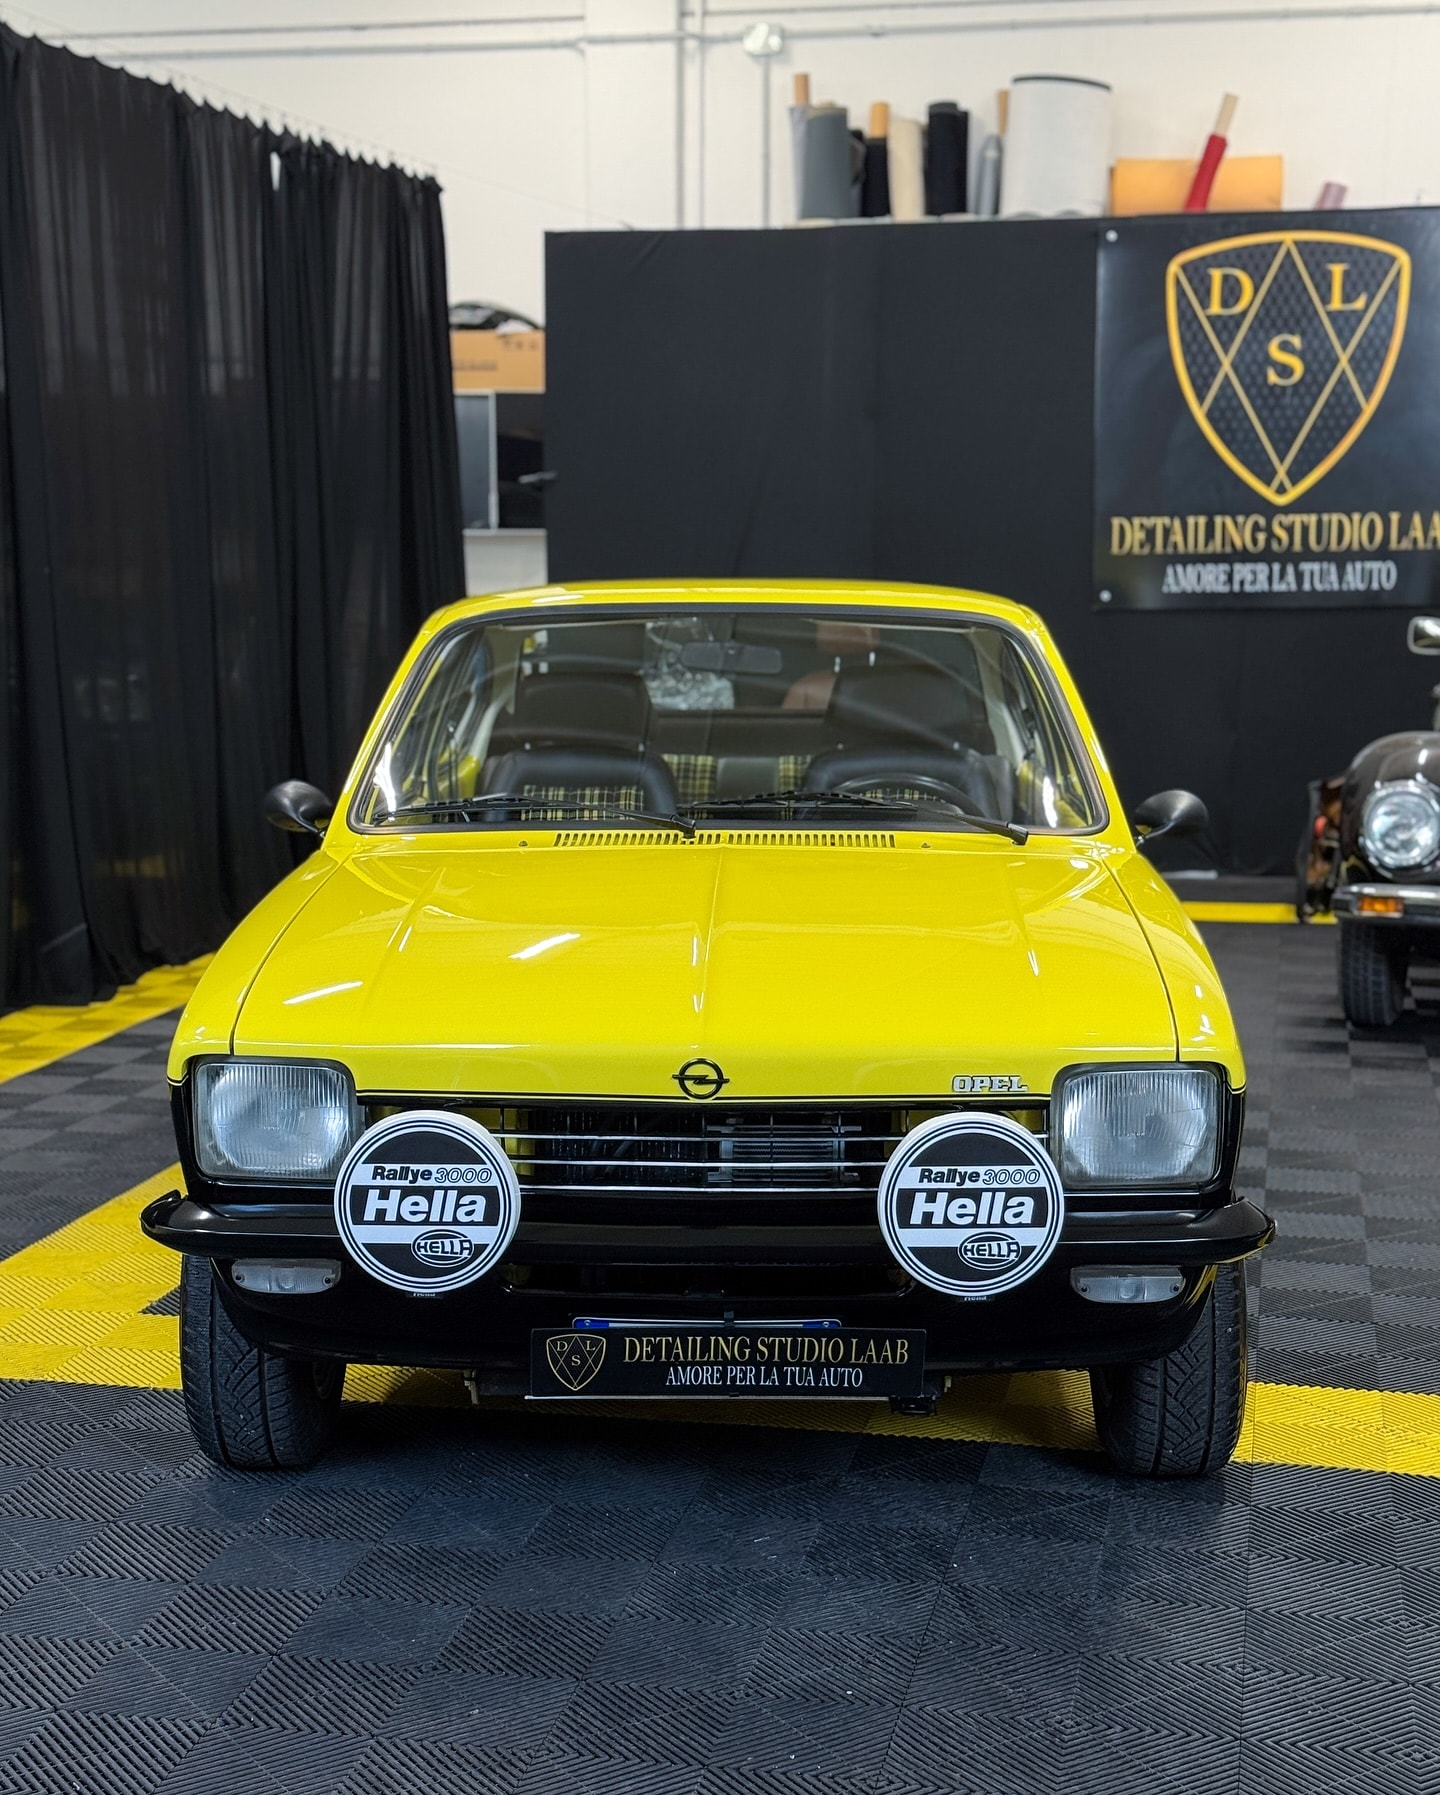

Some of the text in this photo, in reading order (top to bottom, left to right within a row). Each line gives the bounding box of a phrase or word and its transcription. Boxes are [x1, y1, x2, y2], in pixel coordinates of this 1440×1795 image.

[1205, 263, 1367, 316] D L
[1267, 334, 1305, 386] S
[1110, 513, 1267, 555] DETAILING
[1271, 511, 1384, 553] STUDIO
[1162, 559, 1397, 593] AMORE PER LA TUA AUTO
[952, 1075, 1029, 1093] OPEL
[372, 1165, 492, 1184] Rallye 3000
[918, 1168, 1040, 1186] Rallye 3000
[363, 1188, 486, 1223] Hella
[909, 1191, 1035, 1225] Hella
[416, 1239, 473, 1256] HELLA
[963, 1241, 1020, 1259] HELLA
[557, 1341, 596, 1351] D L
[623, 1336, 909, 1364] DETAILING STUDIO LAAB
[571, 1355, 581, 1366] S
[665, 1366, 863, 1387] AMORE PER LA TUA AUTO
